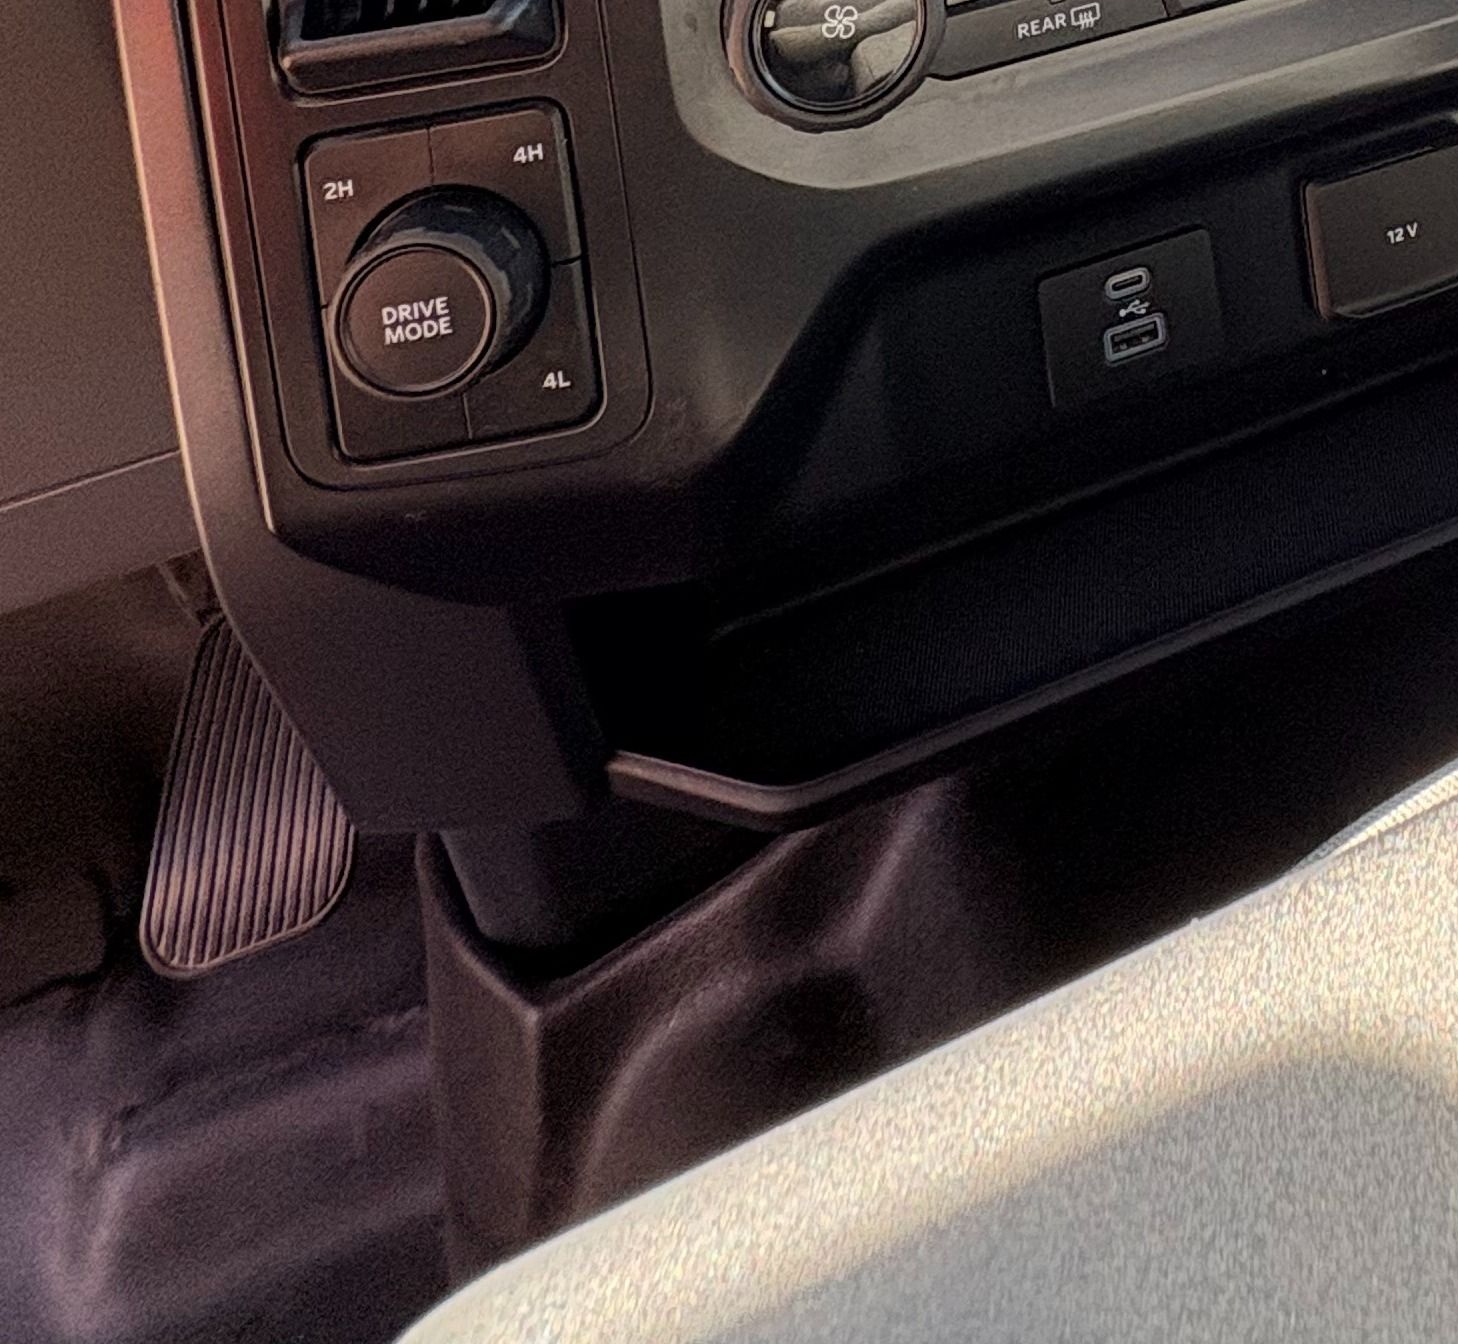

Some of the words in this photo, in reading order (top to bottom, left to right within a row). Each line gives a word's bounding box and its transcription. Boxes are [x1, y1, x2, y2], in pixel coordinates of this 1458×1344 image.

[1017, 12, 1067, 40] REAR
[513, 142, 544, 164] 4H
[323, 179, 354, 201] 2H
[381, 296, 450, 326] DRIVE
[383, 316, 453, 346] MODE
[542, 371, 572, 390] 4L
